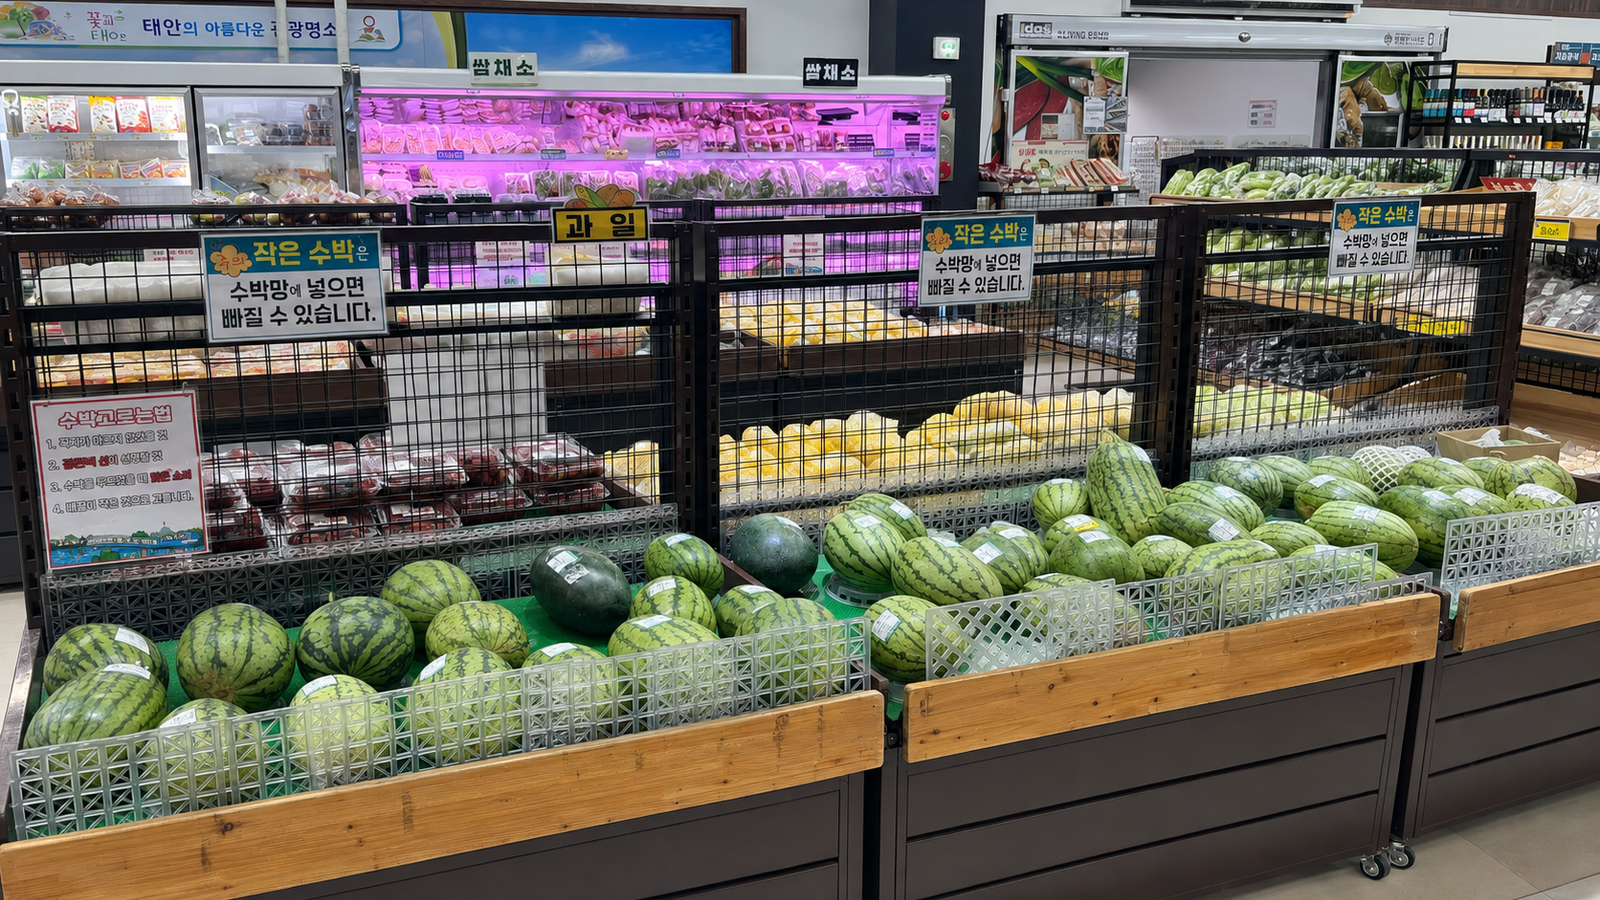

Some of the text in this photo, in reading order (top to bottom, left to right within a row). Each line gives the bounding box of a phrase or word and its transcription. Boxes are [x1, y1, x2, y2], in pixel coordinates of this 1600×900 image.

[142, 18, 198, 37] 태안의
[204, 19, 265, 38] 아름다운
[473, 59, 534, 76] 쌈채소
[805, 63, 855, 80] 쌈채소
[1359, 207, 1381, 224] 작은
[1385, 206, 1414, 224] 수박은
[954, 223, 985, 245] 작은
[989, 222, 1028, 244] 수박은
[253, 239, 369, 266] 작은 수박은
[1360, 252, 1369, 267] 수
[1371, 250, 1409, 266] 있습니다.
[935, 253, 1021, 274] 수박망에 넣으면
[230, 276, 365, 302] 수박망에 넣으면
[927, 274, 1025, 296] 빠질 수 있습니다.
[221, 302, 376, 328] 빠질 수 있습니다.
[46, 438, 57, 450] 1.
[156, 429, 169, 441] 것
[48, 460, 60, 471] 2.
[151, 450, 163, 462] 것
[50, 482, 62, 493] 3.
[52, 504, 64, 514] 4.
[120, 494, 151, 507] 것으로
